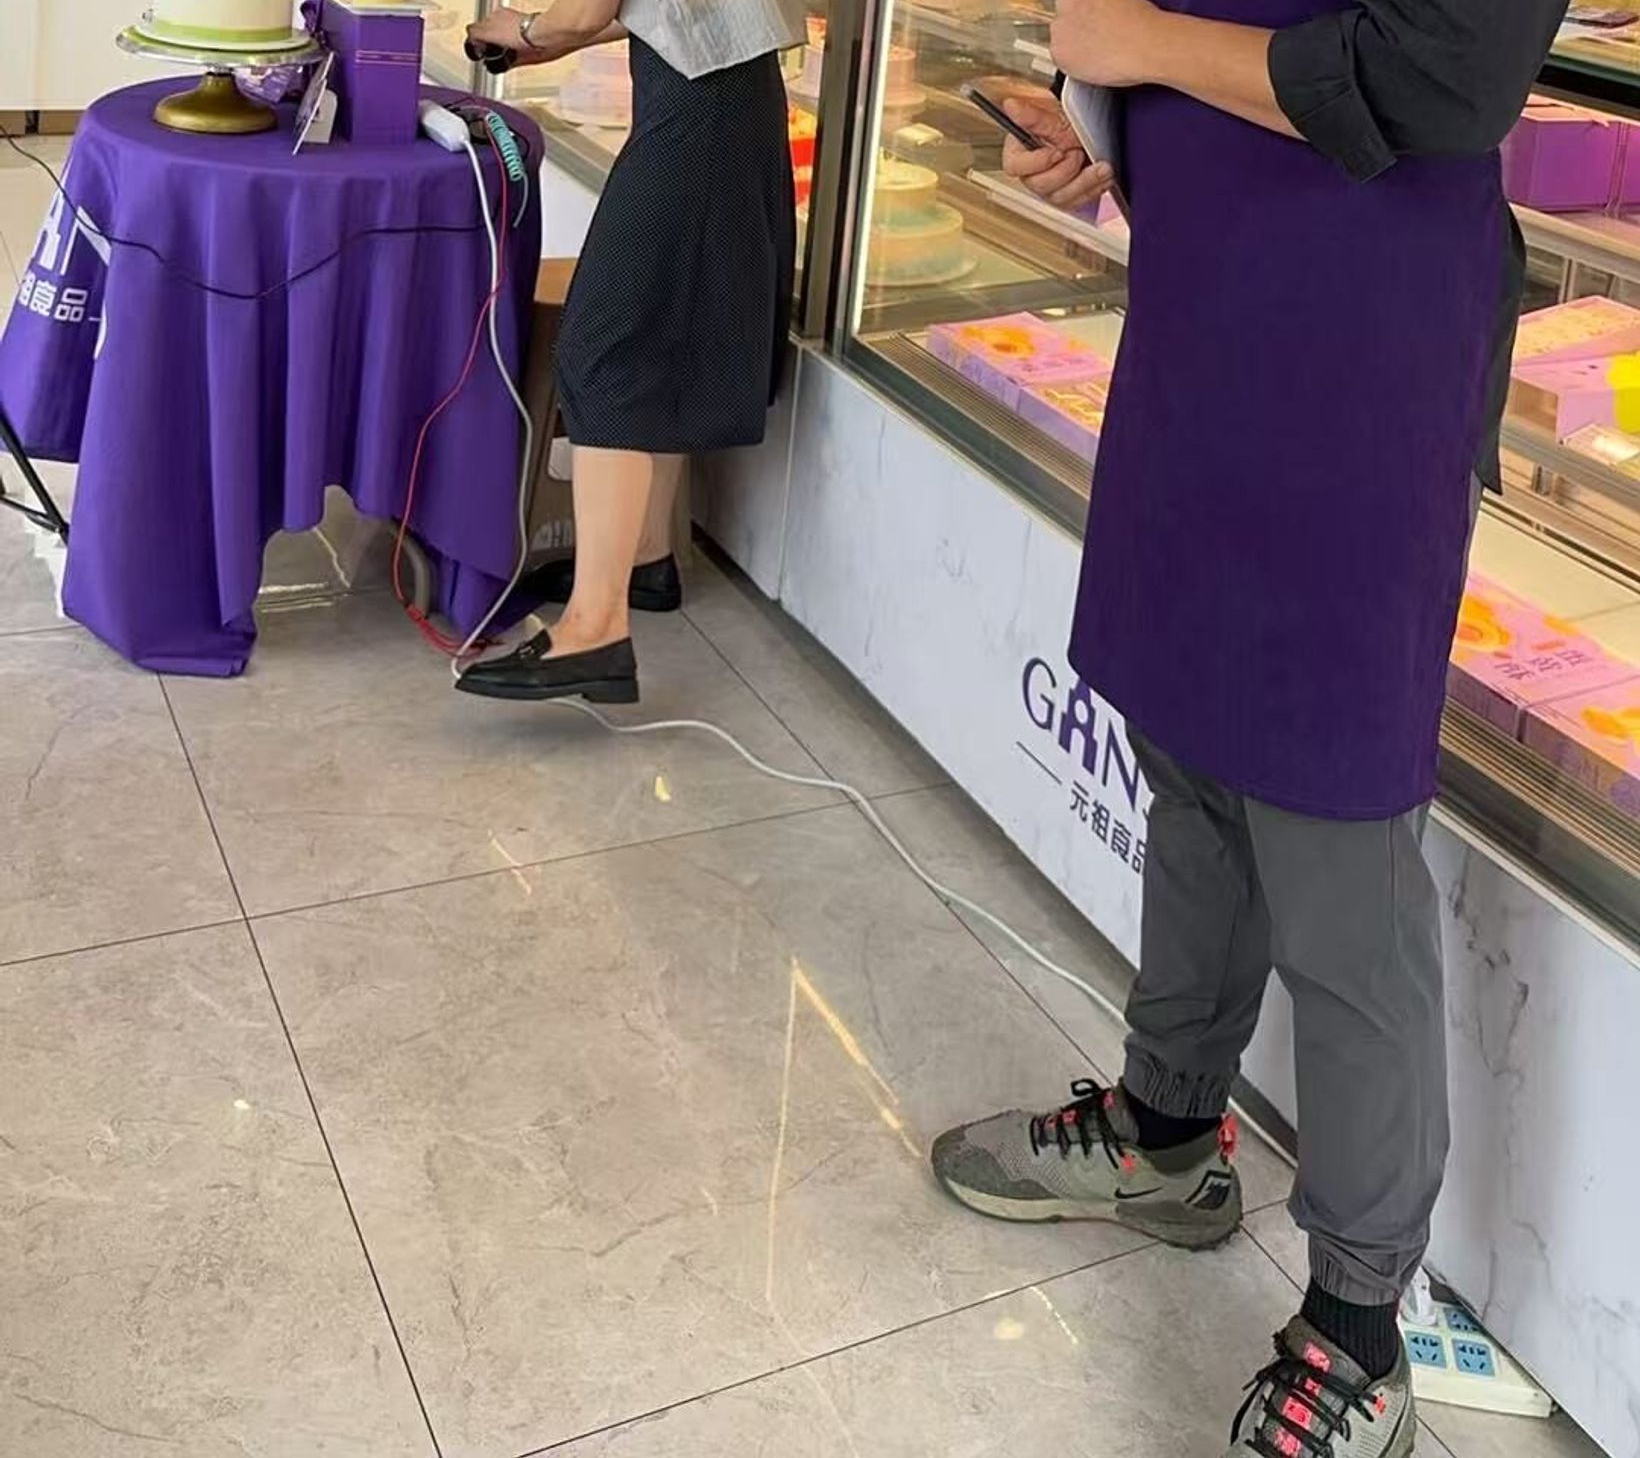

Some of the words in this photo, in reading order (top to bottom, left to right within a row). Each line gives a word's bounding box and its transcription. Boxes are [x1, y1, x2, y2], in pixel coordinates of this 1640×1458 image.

[1022, 656, 1149, 818] GAN
[1070, 780, 1147, 874] 元祖食品
